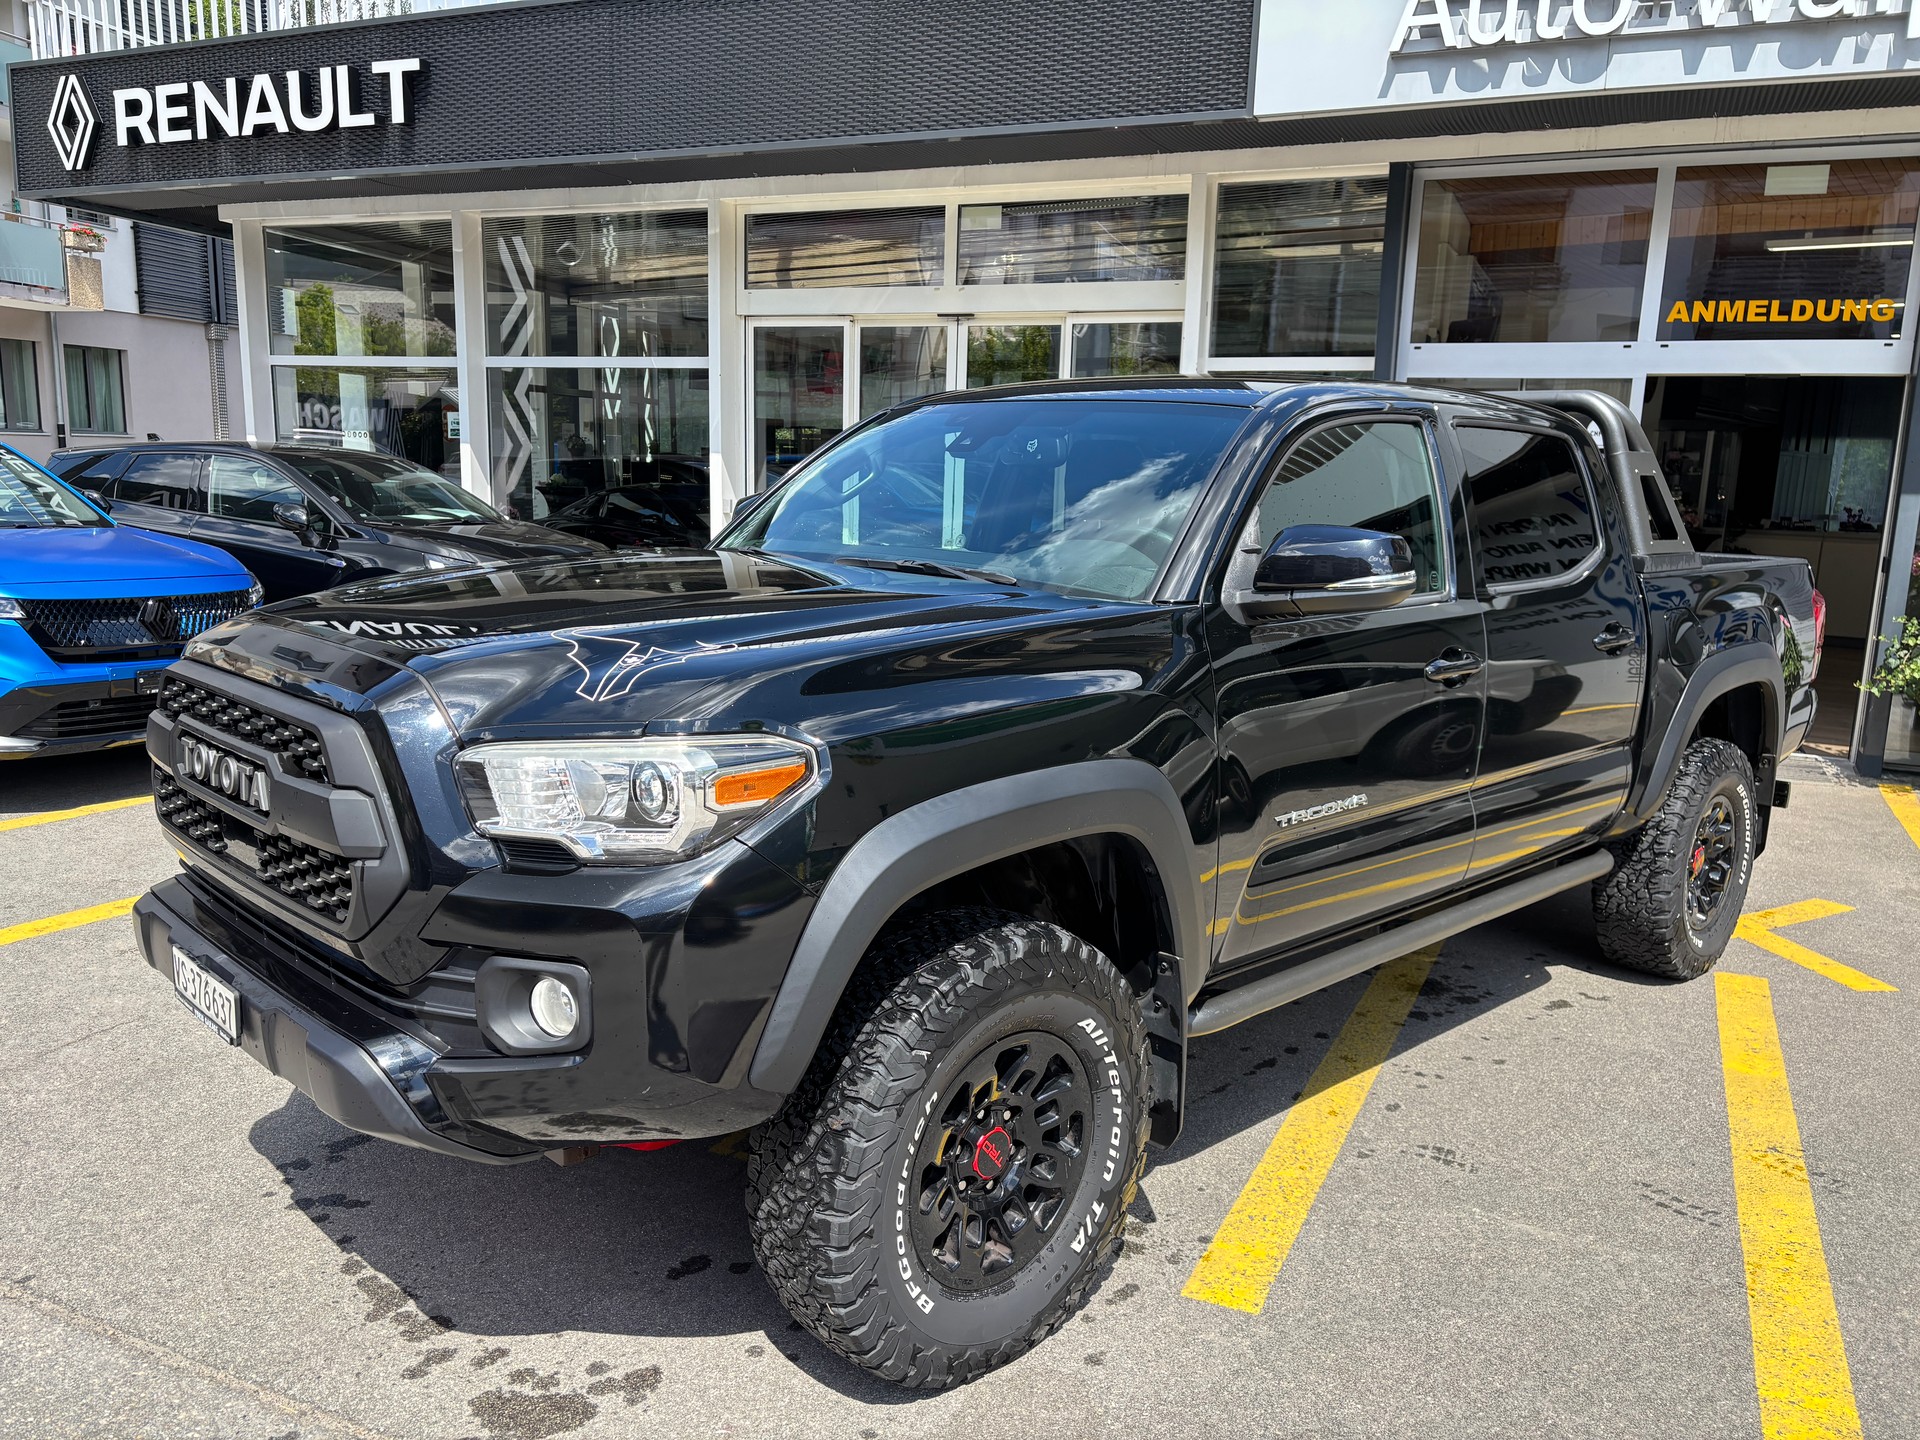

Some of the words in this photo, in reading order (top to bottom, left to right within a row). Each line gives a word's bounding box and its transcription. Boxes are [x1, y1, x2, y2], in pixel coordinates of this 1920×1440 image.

[113, 58, 421, 147] RENAULT
[1666, 298, 1896, 323] ANMELDUNG
[178, 735, 270, 811] TOYOTA
[1275, 793, 1368, 828] TACOMA
[1077, 1017, 1121, 1182] All-Terrain
[982, 1140, 1002, 1168] TRD
[895, 1091, 938, 1315] BFGoodrich
[1070, 1200, 1104, 1253] T/A
